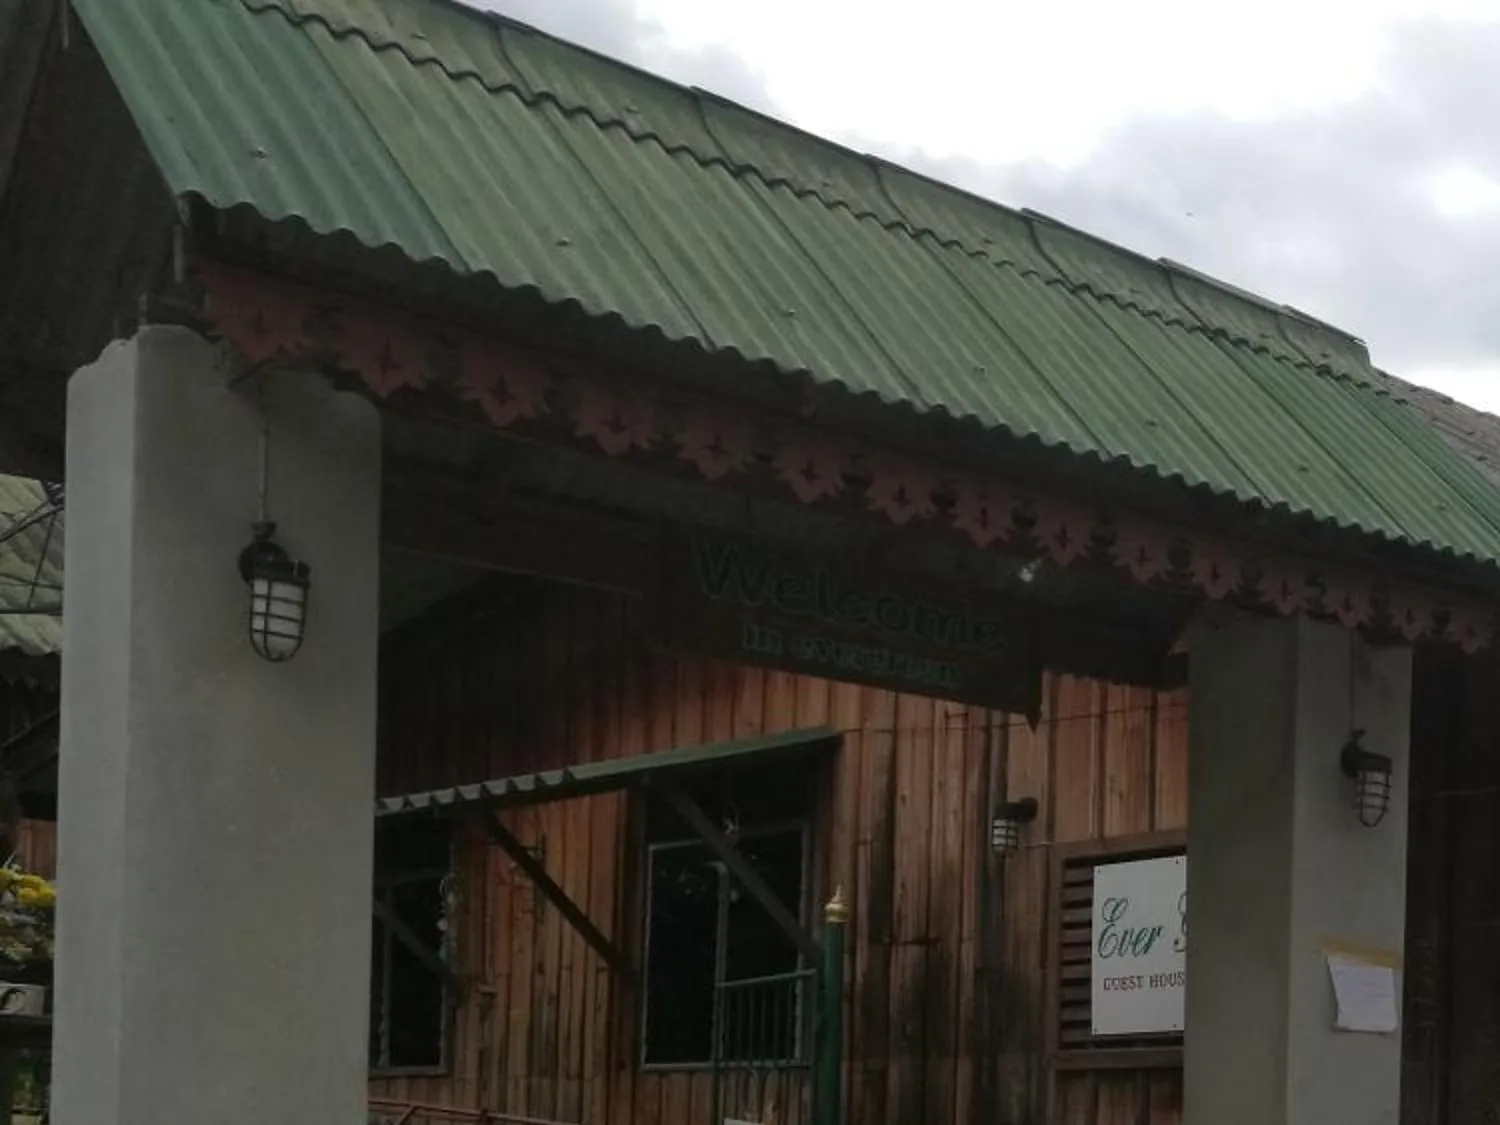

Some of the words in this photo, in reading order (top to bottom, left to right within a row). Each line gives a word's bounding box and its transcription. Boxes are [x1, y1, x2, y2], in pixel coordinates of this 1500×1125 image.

[690, 534, 1008, 652] Welcome
[1098, 897, 1164, 959] Ever
[1103, 975, 1144, 991] GUEST
[1150, 971, 1185, 989] HOUS
